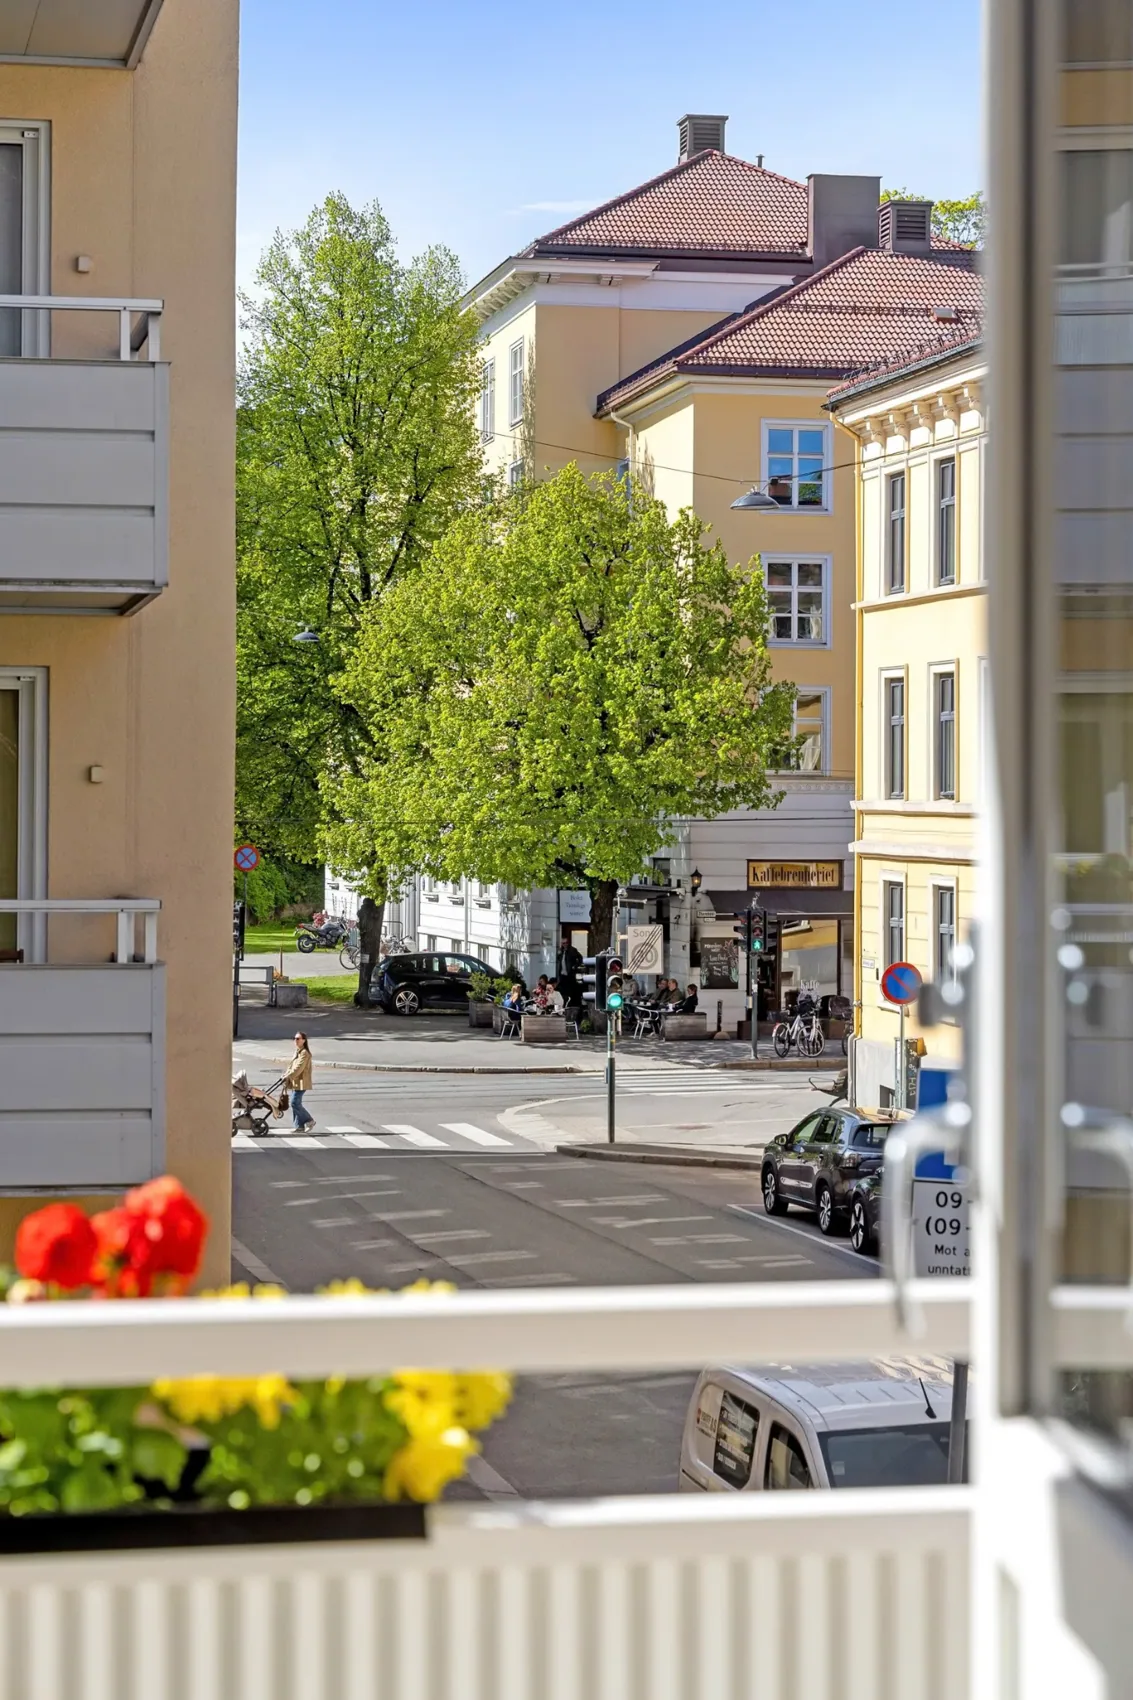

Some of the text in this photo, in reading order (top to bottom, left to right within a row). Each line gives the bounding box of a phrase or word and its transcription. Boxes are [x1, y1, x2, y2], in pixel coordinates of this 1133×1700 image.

[752, 866, 835, 882] Kaffebrenneriet
[633, 929, 654, 938] Son
[934, 1244, 957, 1257] Mot
